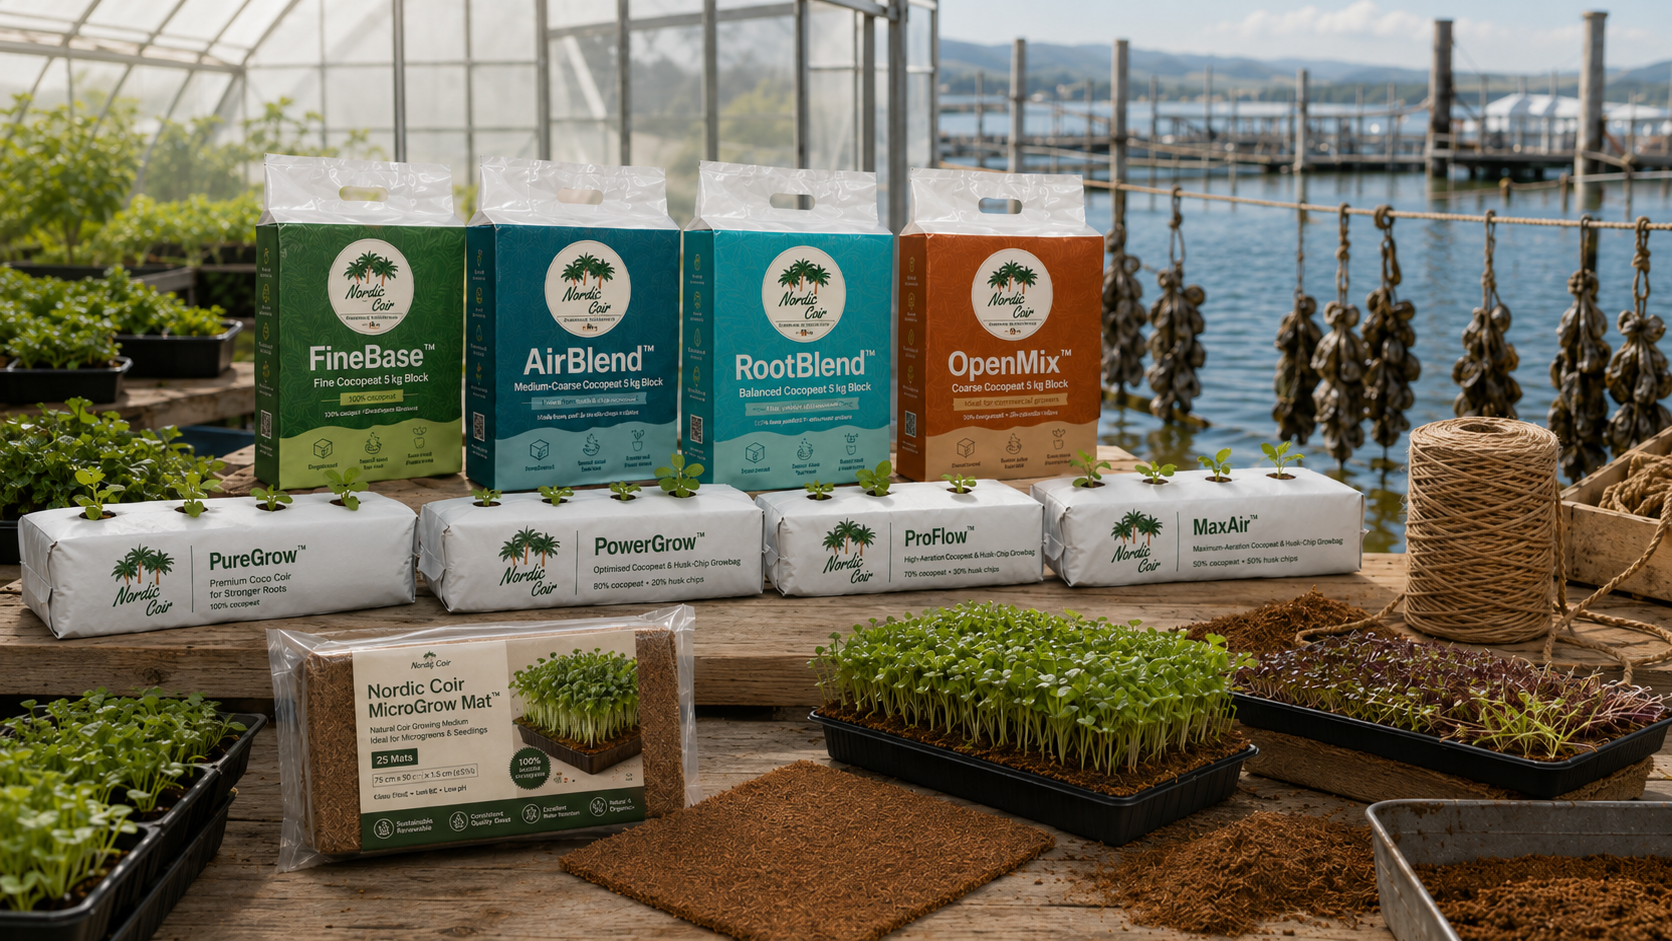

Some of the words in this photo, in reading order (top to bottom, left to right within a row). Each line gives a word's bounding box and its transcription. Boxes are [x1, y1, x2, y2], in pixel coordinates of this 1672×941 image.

[345, 284, 385, 300] Nordic
[562, 286, 601, 302] Nordic
[778, 291, 817, 307] Nordic
[988, 291, 1025, 307] Nordic
[372, 298, 395, 312] Coir
[588, 301, 611, 315] Coir
[804, 305, 827, 320] Coir
[1013, 305, 1034, 319] Coir
[309, 343, 436, 371] FineBase™
[523, 345, 654, 375] AirBlend™
[735, 349, 875, 381] RootBlend™
[948, 349, 1071, 382] OpenMix™
[313, 378, 335, 388] Fine
[336, 376, 382, 388] Cocopeat
[384, 375, 390, 384] 5
[391, 374, 403, 386] kg
[404, 373, 429, 383] Block
[514, 381, 581, 391] Medium-Coarse
[583, 379, 622, 390] Cocopeat
[630, 378, 640, 389] kg
[641, 377, 663, 387] Block
[951, 383, 982, 393] Coarse
[984, 381, 1025, 392] Cocopeat
[1033, 380, 1044, 391] kg
[1045, 379, 1069, 389] Block
[739, 386, 782, 398] Balanced
[784, 385, 827, 397] Cocopeat
[836, 383, 846, 394] kg
[848, 382, 871, 392] Block
[1193, 513, 1258, 536] MaxAir™
[594, 531, 705, 556] PowerGrow™
[904, 525, 975, 547] ProFlow™
[1251, 540, 1279, 551] Cocopeat
[1279, 540, 1285, 548] &
[1317, 537, 1344, 547] Growbag
[209, 544, 306, 571] PureGrow™
[904, 554, 945, 564] High-Aeration
[946, 552, 973, 562] Cocopeat
[974, 551, 979, 559] &
[1111, 542, 1151, 564] Nordic
[1209, 558, 1240, 568] cocopeat
[1263, 555, 1279, 564] husk
[1280, 554, 1298, 564] chips
[593, 565, 631, 575] Optimised
[632, 562, 666, 574] Cocopeat
[711, 557, 742, 568] Growbag
[823, 552, 864, 574] Nordic
[1138, 558, 1161, 573] Coir
[210, 577, 247, 587] Premium
[249, 574, 272, 585] Coco
[273, 572, 292, 582] Coir
[499, 563, 546, 587] Nordic
[850, 569, 873, 584] Coir
[904, 570, 918, 578] 70%
[918, 568, 947, 578] cocopeat
[983, 565, 1000, 575] chips
[531, 581, 557, 597] Coir
[593, 581, 609, 590] 80%
[611, 580, 644, 590] cocopeat
[651, 577, 667, 587] 20%
[668, 576, 685, 586] husk
[686, 575, 705, 586] chips
[112, 581, 160, 607] Nordic
[210, 590, 222, 599] for
[224, 586, 261, 600] Stronger
[262, 584, 287, 595] Roots
[145, 599, 173, 617] Coir
[210, 602, 228, 611] 100%
[436, 659, 451, 667] Coir
[367, 680, 425, 699] Nordic
[430, 677, 465, 694] Coir
[368, 698, 457, 719] MicroGrow
[461, 691, 500, 710] Mat™
[370, 725, 395, 734] Natural
[396, 723, 410, 731] Coir
[412, 721, 441, 730] Growing
[441, 718, 469, 727] Medium
[370, 736, 388, 744] Ideal
[389, 735, 399, 743] for
[401, 731, 445, 741] Microgreens
[453, 726, 488, 736] Seedlings
[376, 755, 389, 765] 25
[390, 753, 413, 764] Mats
[519, 757, 541, 766] 100%
[457, 785, 467, 793] pH
